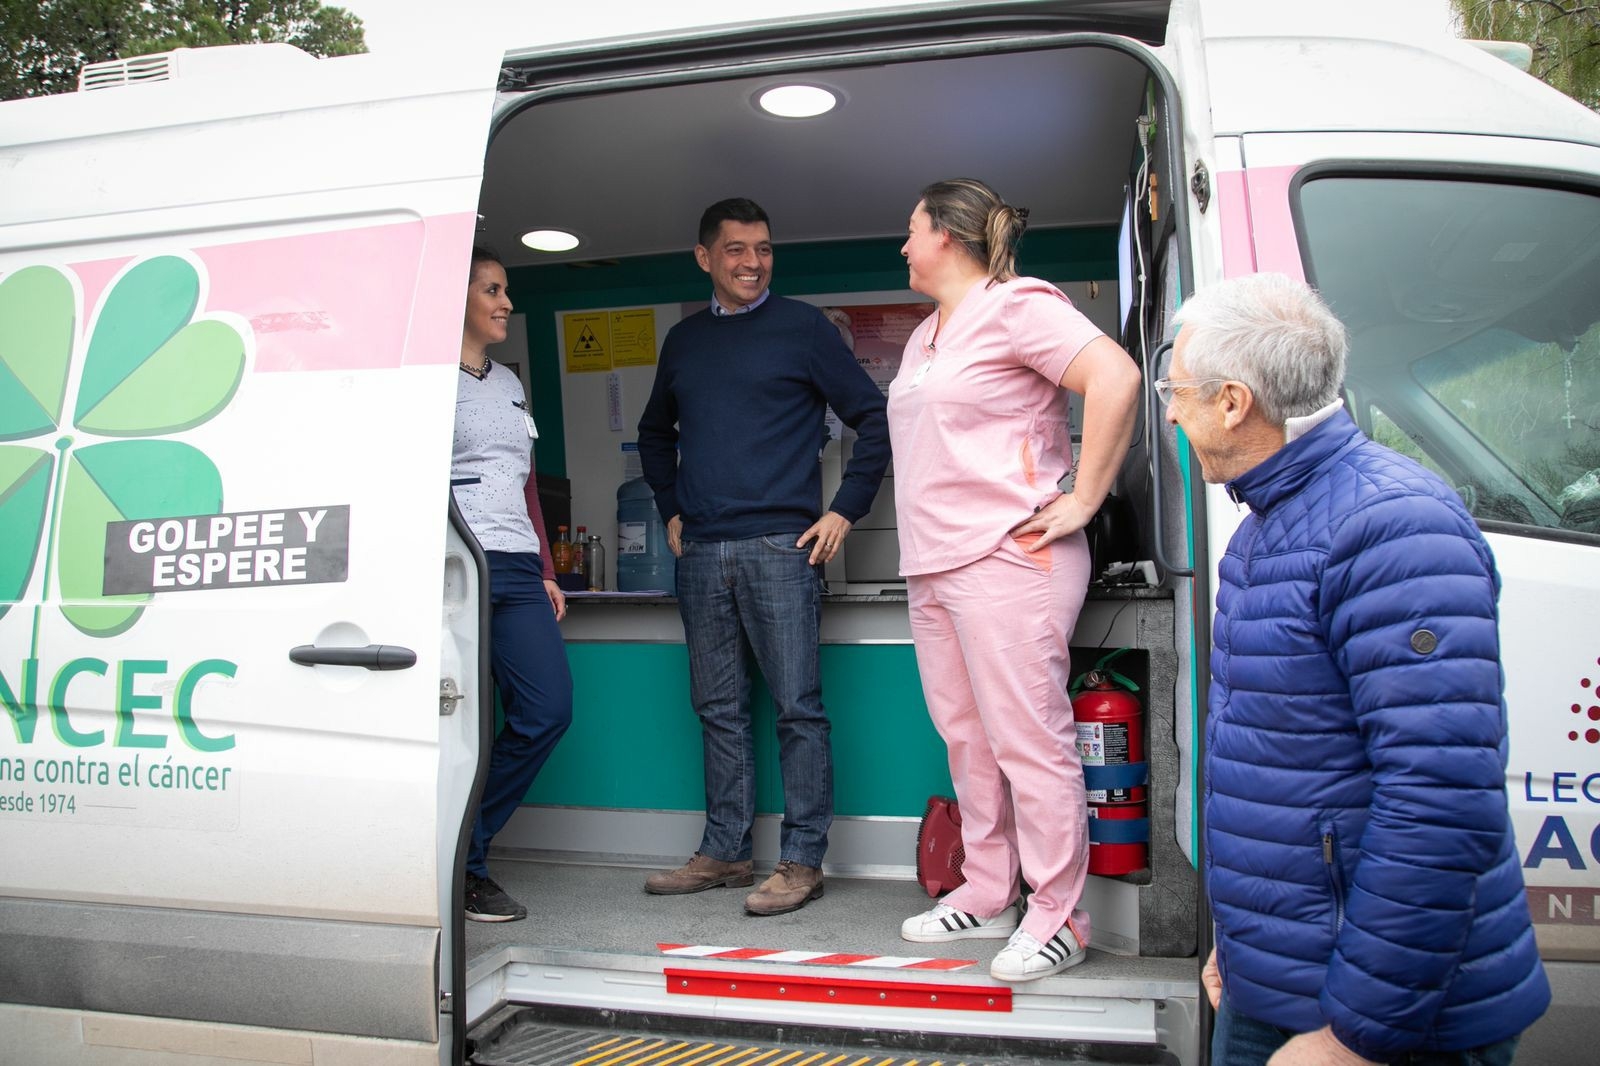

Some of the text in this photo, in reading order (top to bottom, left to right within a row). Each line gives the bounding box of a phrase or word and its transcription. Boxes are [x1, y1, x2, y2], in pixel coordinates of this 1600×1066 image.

[129, 509, 328, 553] GOLPEE Y
[152, 547, 307, 587] ESPERE
[33, 755, 110, 786] contra
[118, 754, 140, 787] el
[148, 755, 232, 791] cáncer
[39, 793, 77, 814] 1974
